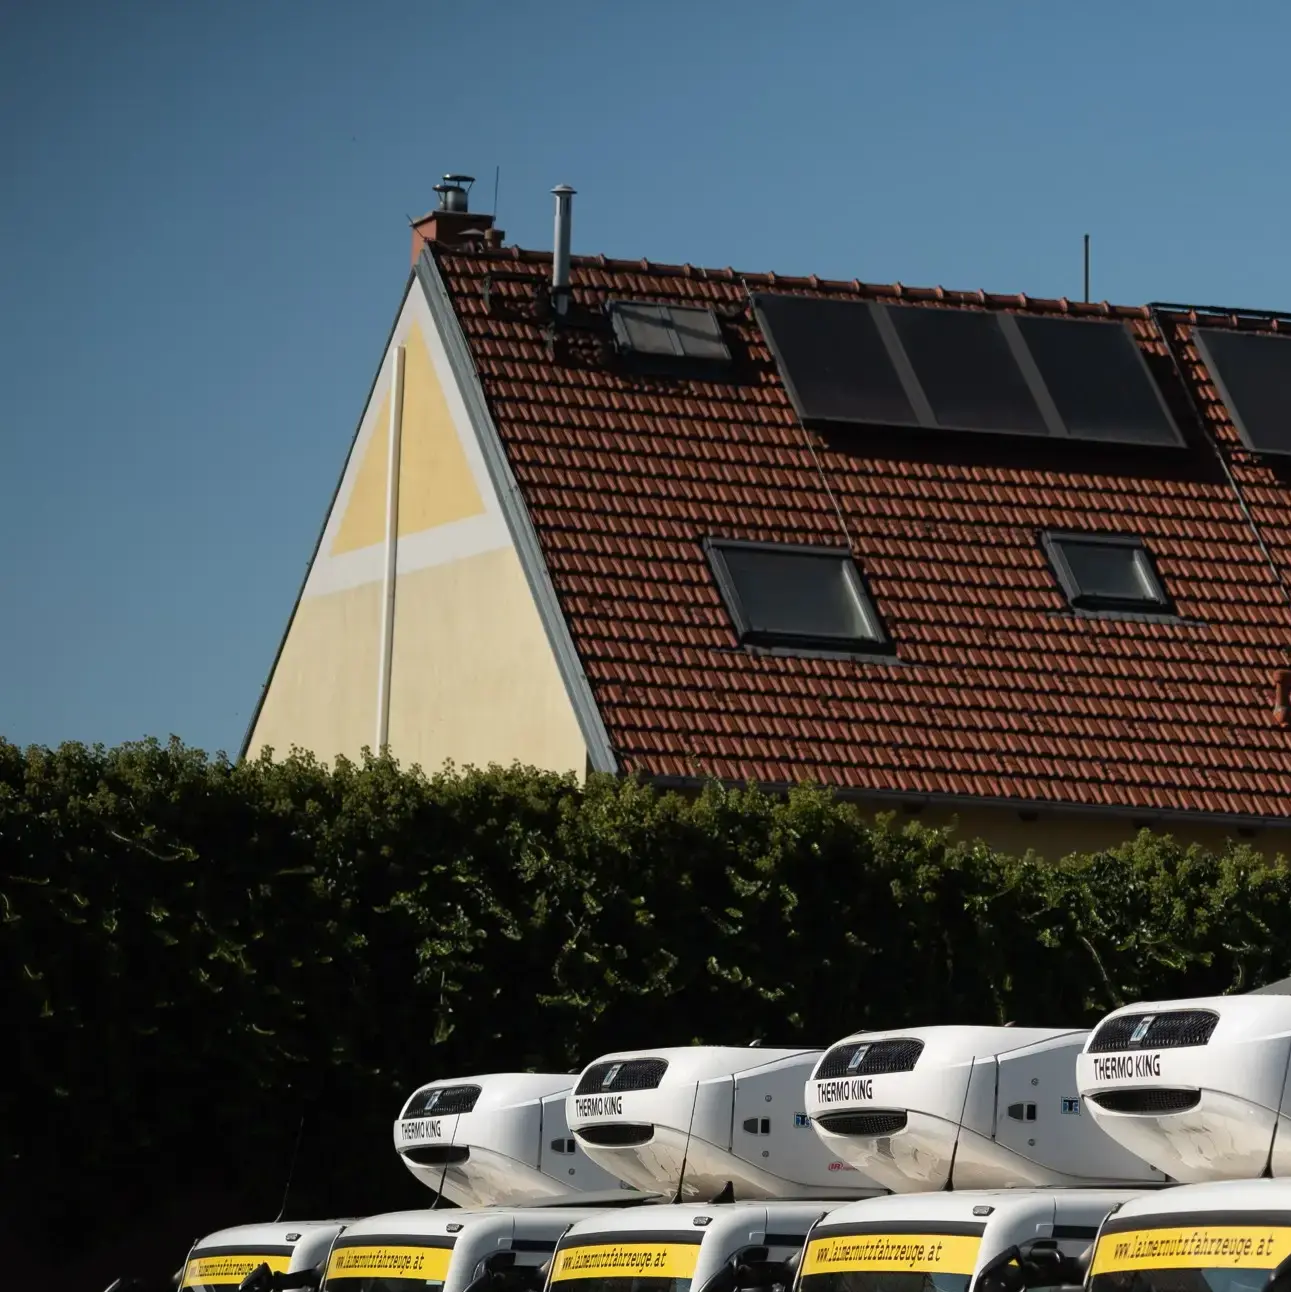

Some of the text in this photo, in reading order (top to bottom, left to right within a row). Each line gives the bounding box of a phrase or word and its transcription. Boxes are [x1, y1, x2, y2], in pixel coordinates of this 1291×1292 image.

[1093, 1054, 1161, 1080] THERMO KING
[817, 1079, 873, 1103] THERMO KING
[575, 1096, 622, 1117] THERMO KING
[401, 1119, 441, 1141] THERMO KING
[562, 1247, 667, 1273] www.laimernutzfahrzeuge.at
[816, 1240, 942, 1267] www.laimernutzfahrzeuge.at
[1113, 1232, 1274, 1263] www.laimernutzfahrzeuge.at
[335, 1250, 425, 1275] www.laimernutzfahrzeuge.at
